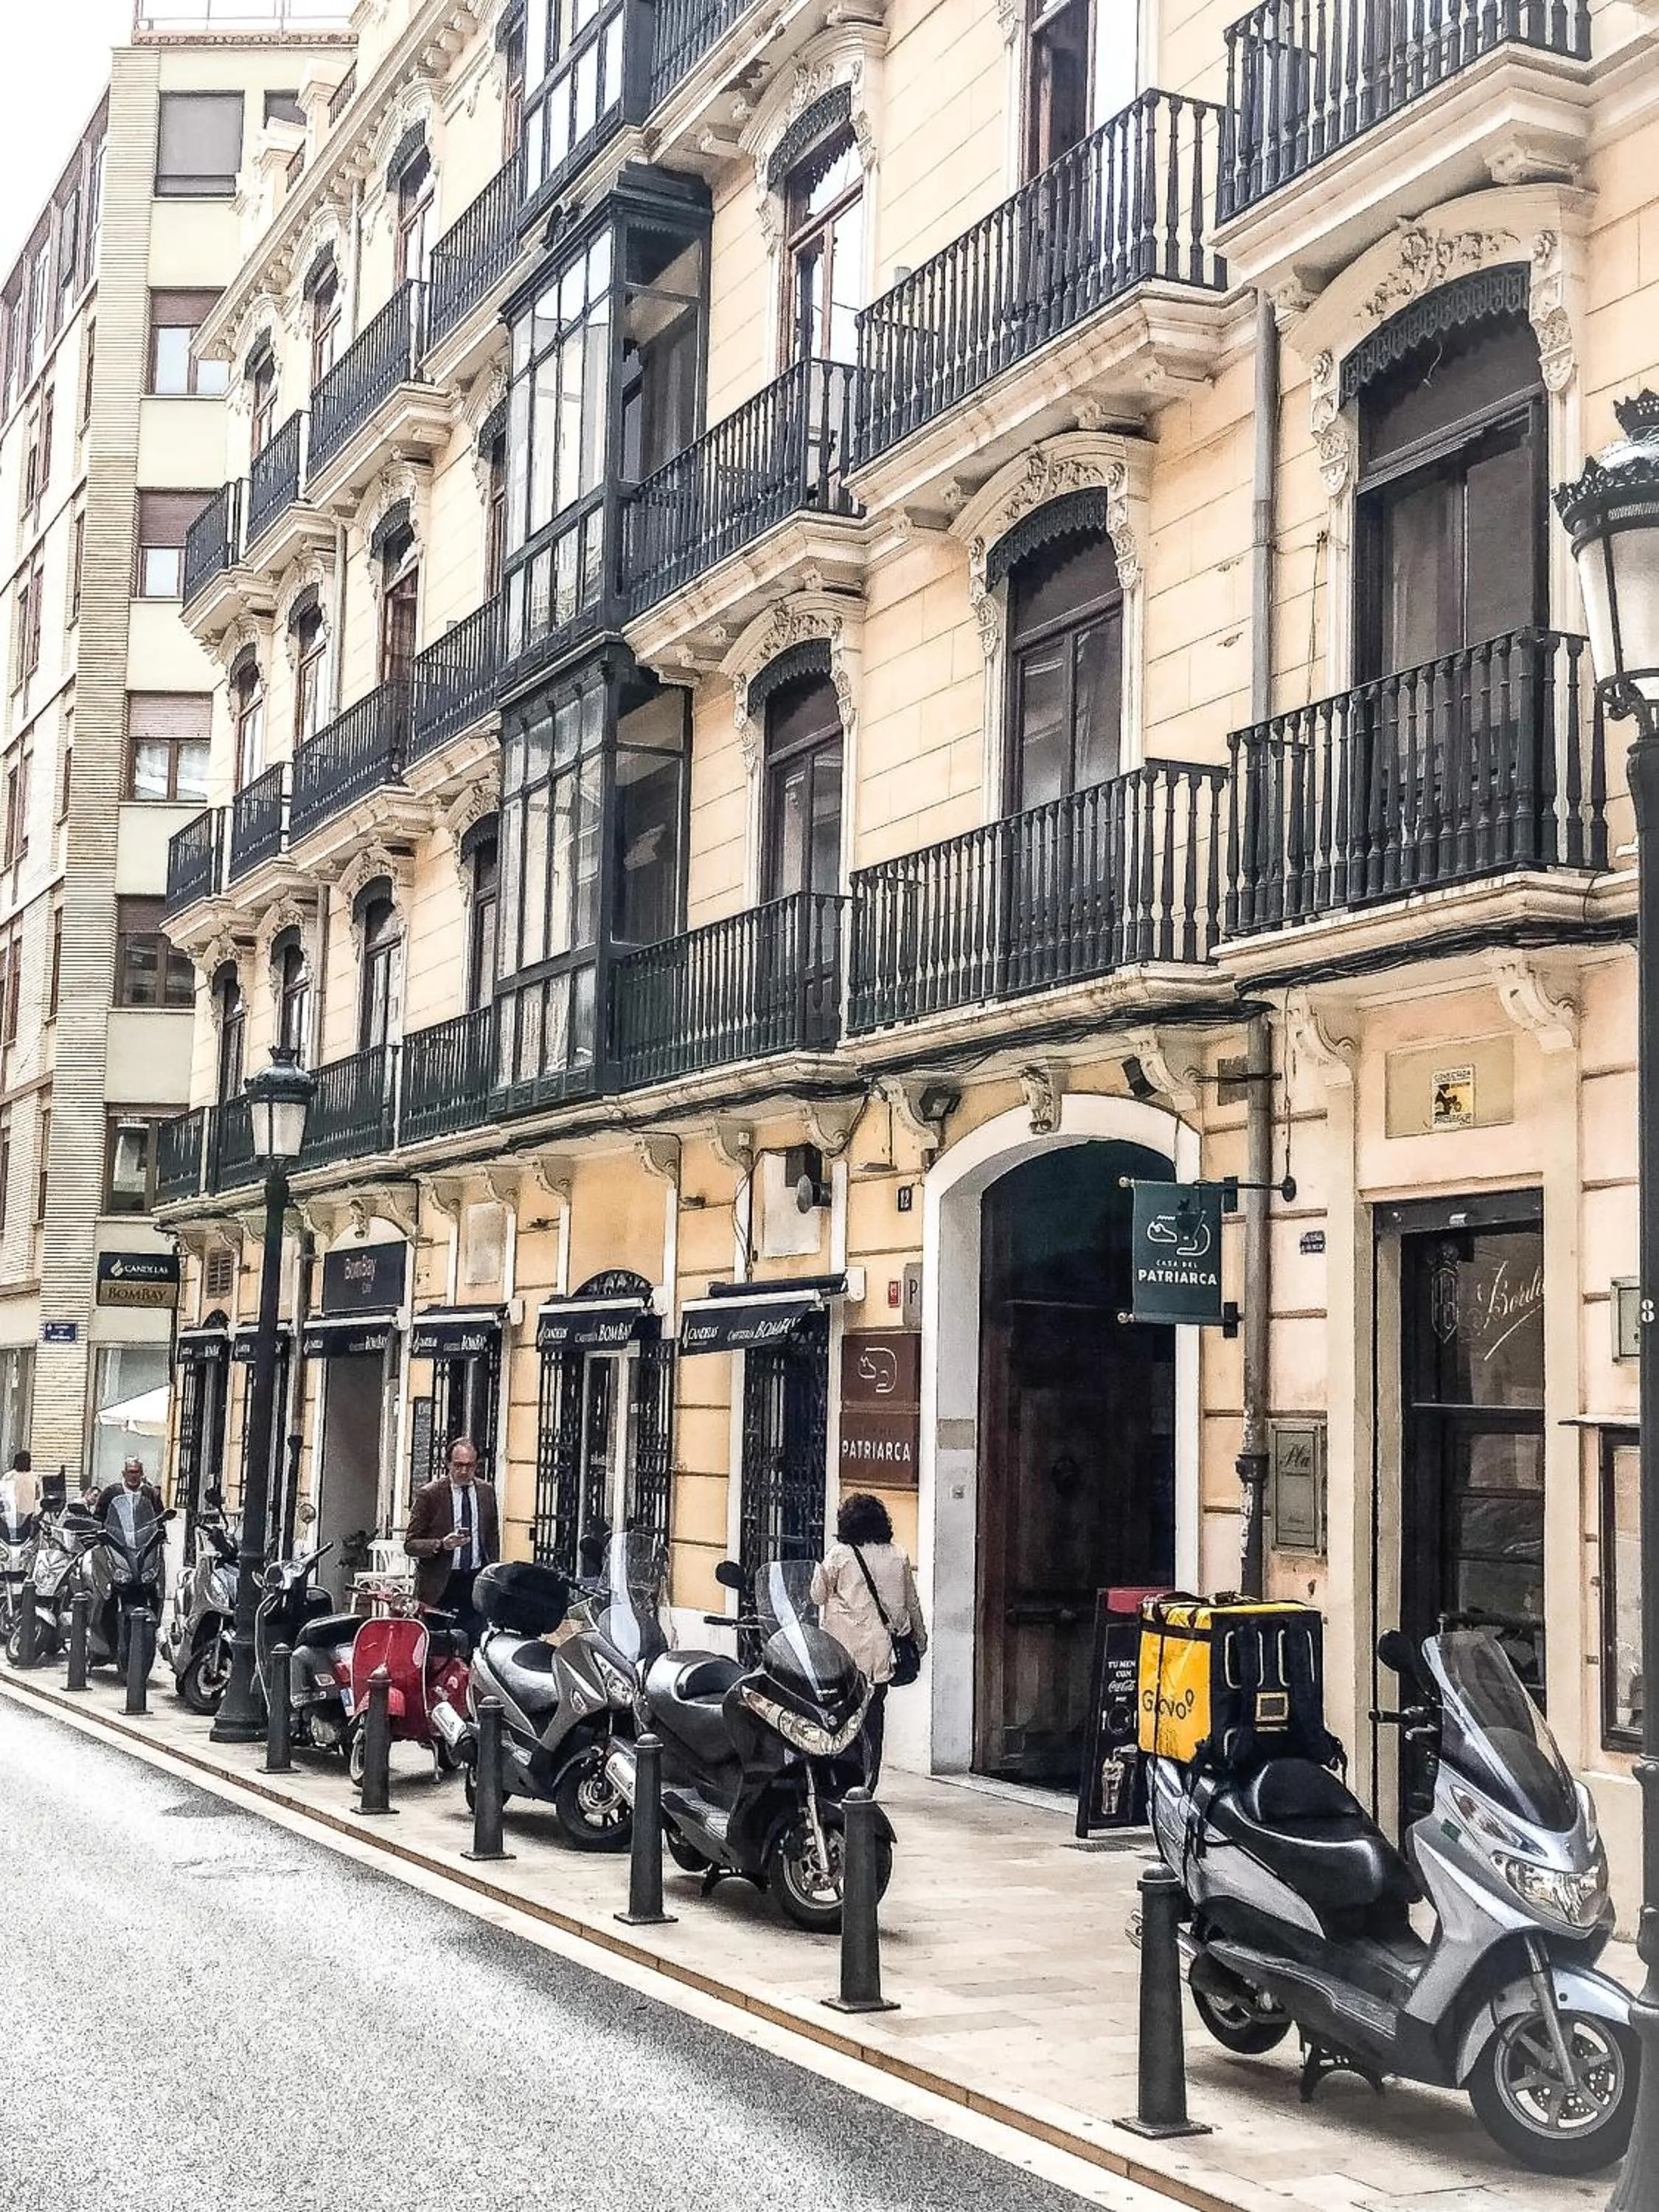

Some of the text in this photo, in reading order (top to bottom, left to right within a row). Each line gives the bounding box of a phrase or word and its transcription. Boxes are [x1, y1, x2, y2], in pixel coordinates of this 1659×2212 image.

[1138, 1270, 1217, 1285] PATRIARCA
[841, 1439, 911, 1461] PATRIARCA
[1119, 1660, 1136, 1669] MEN
[1142, 1689, 1186, 1720] Govo
